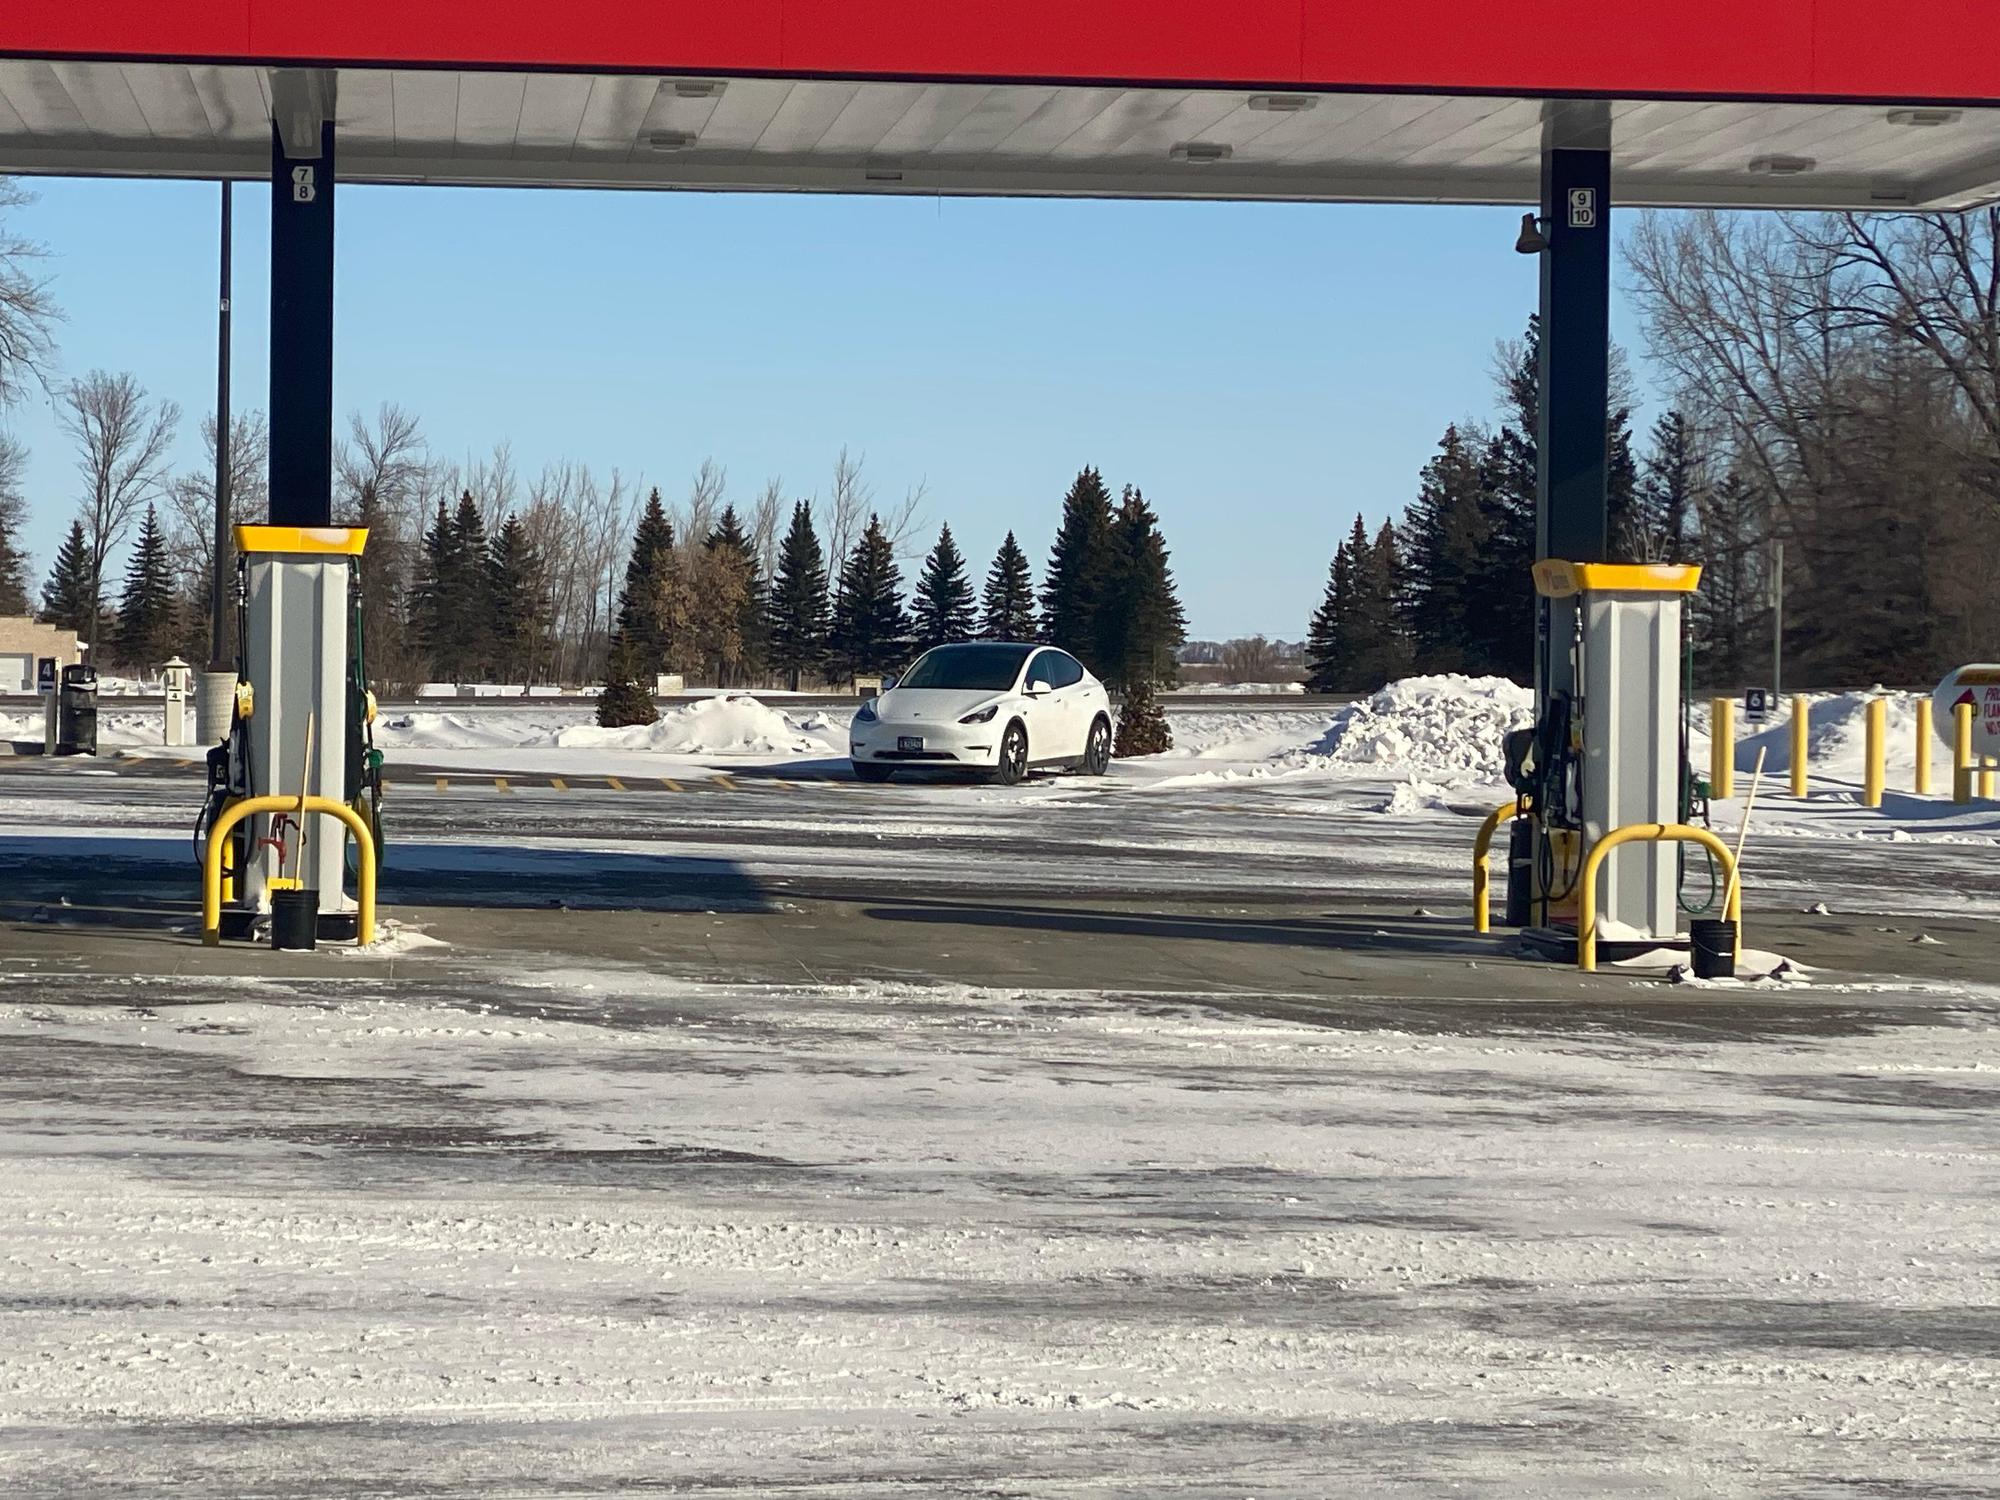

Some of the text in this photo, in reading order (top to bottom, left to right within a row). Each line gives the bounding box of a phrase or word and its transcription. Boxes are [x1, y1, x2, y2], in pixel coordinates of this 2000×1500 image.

[298, 168, 308, 182] 7
[299, 185, 309, 199] 8
[1577, 192, 1587, 206] 9
[1574, 209, 1590, 223] 10
[42, 662, 51, 678] 4
[1751, 693, 1761, 707] 6
